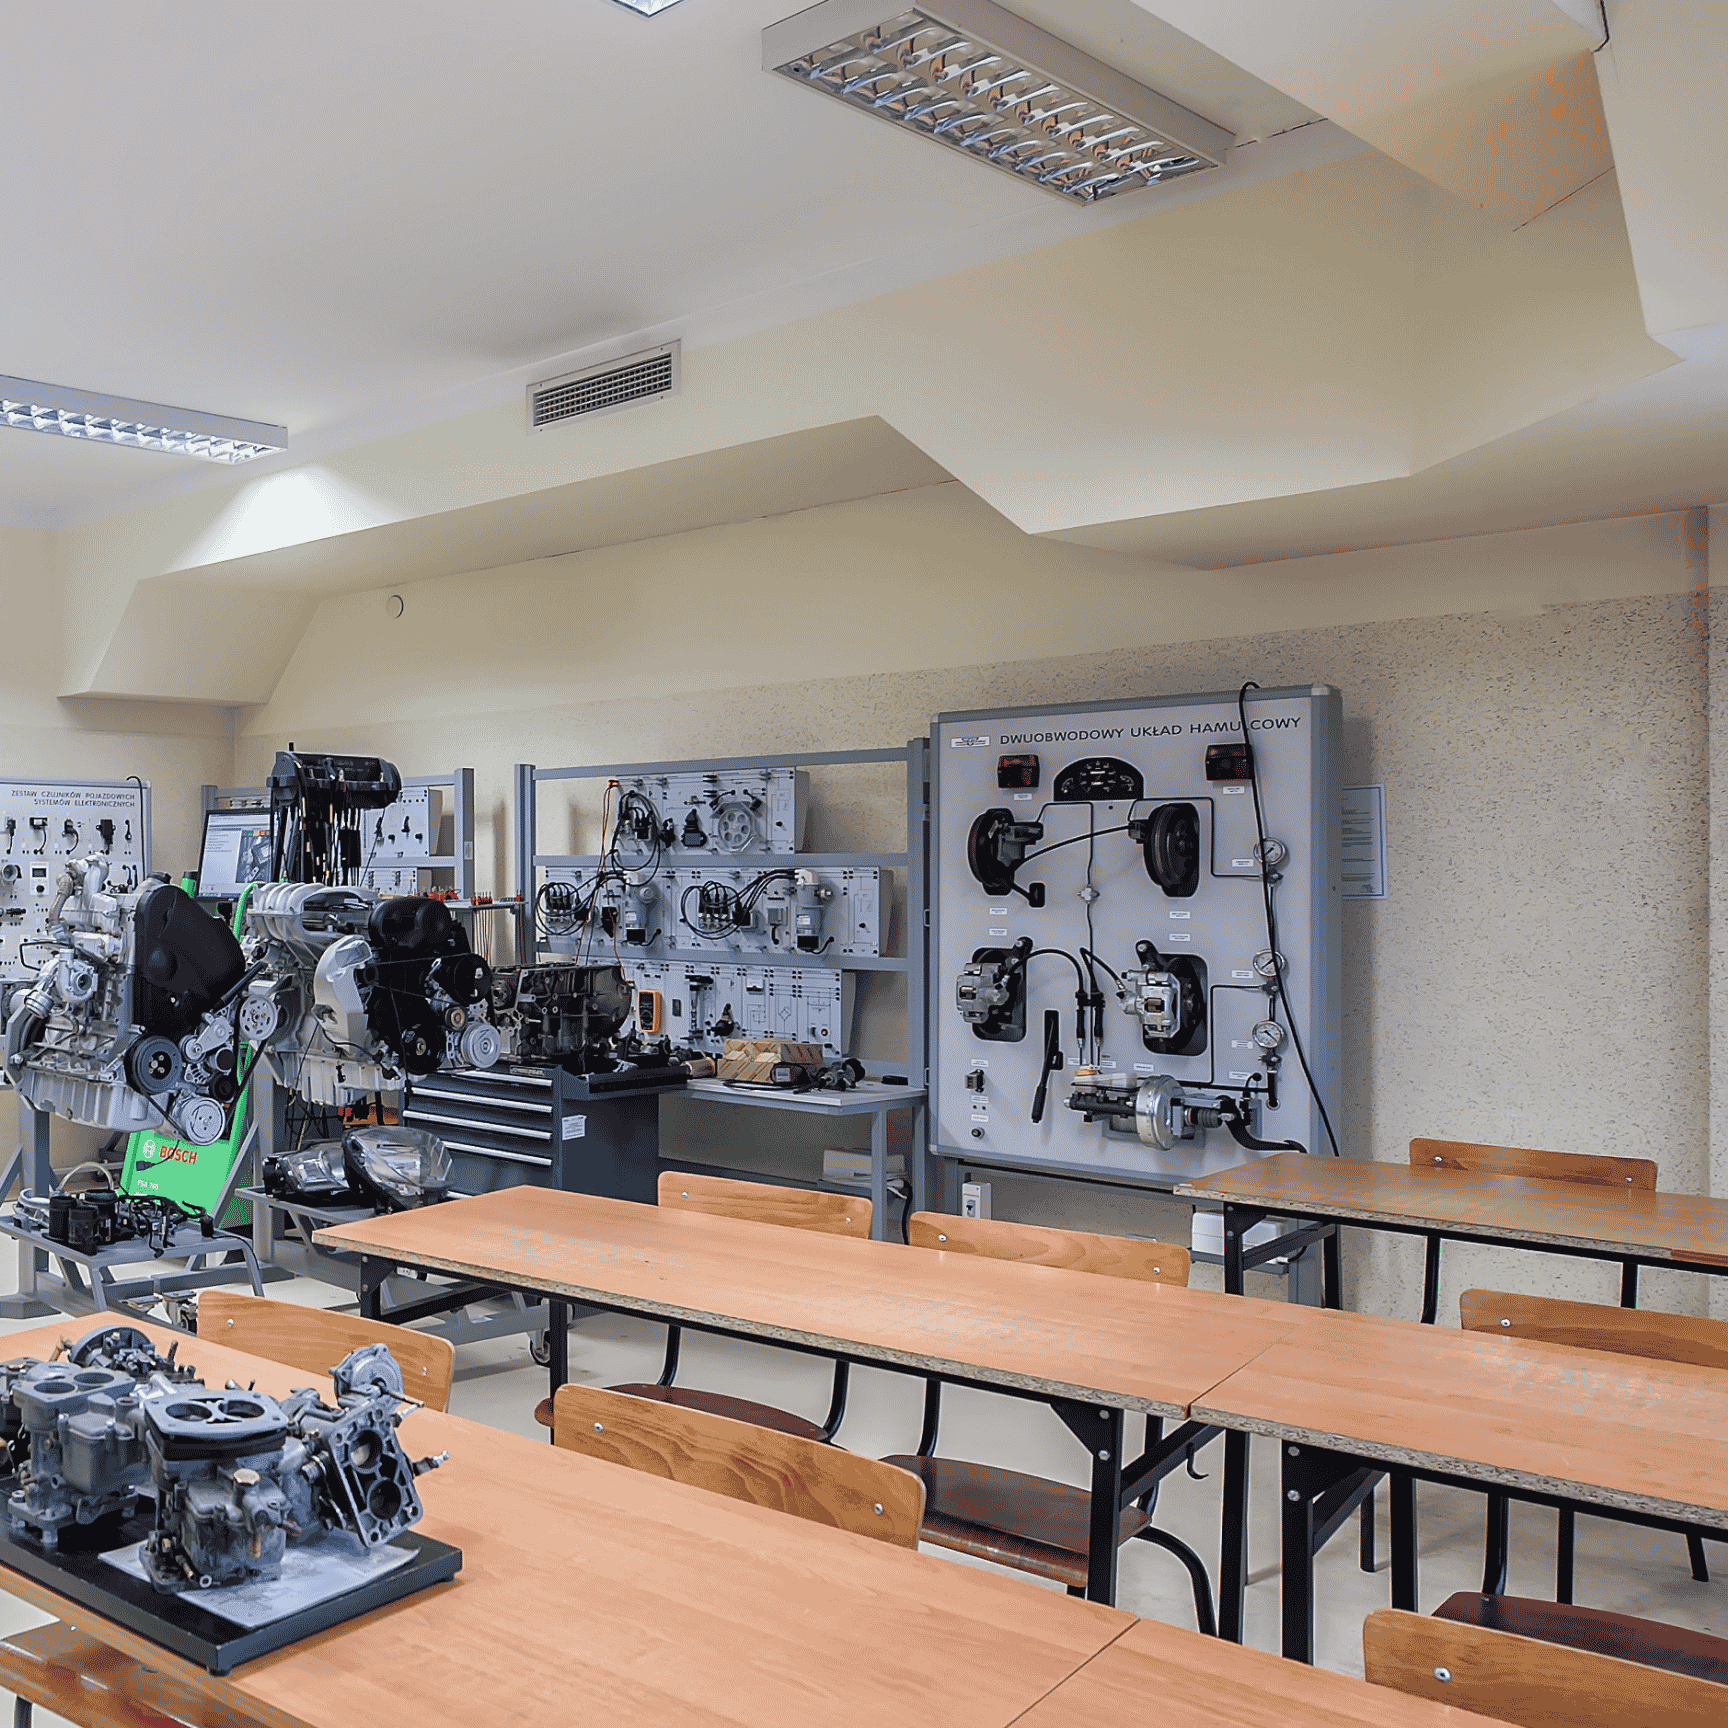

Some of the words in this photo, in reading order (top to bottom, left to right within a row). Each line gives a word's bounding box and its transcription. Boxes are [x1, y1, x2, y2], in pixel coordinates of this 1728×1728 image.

[1000, 728, 1124, 745] DWUOBWODOWY
[1131, 724, 1182, 738] UKŁAD
[1190, 717, 1302, 734] HAMUCOWY
[34, 798, 70, 806] SYSTEMÓW
[74, 799, 135, 807] ELEKTRONICZNYCH
[41, 791, 81, 799] CZUJNIKÓW
[85, 792, 135, 800] POJAZDOWYCH
[159, 1145, 198, 1164] BOSCH
